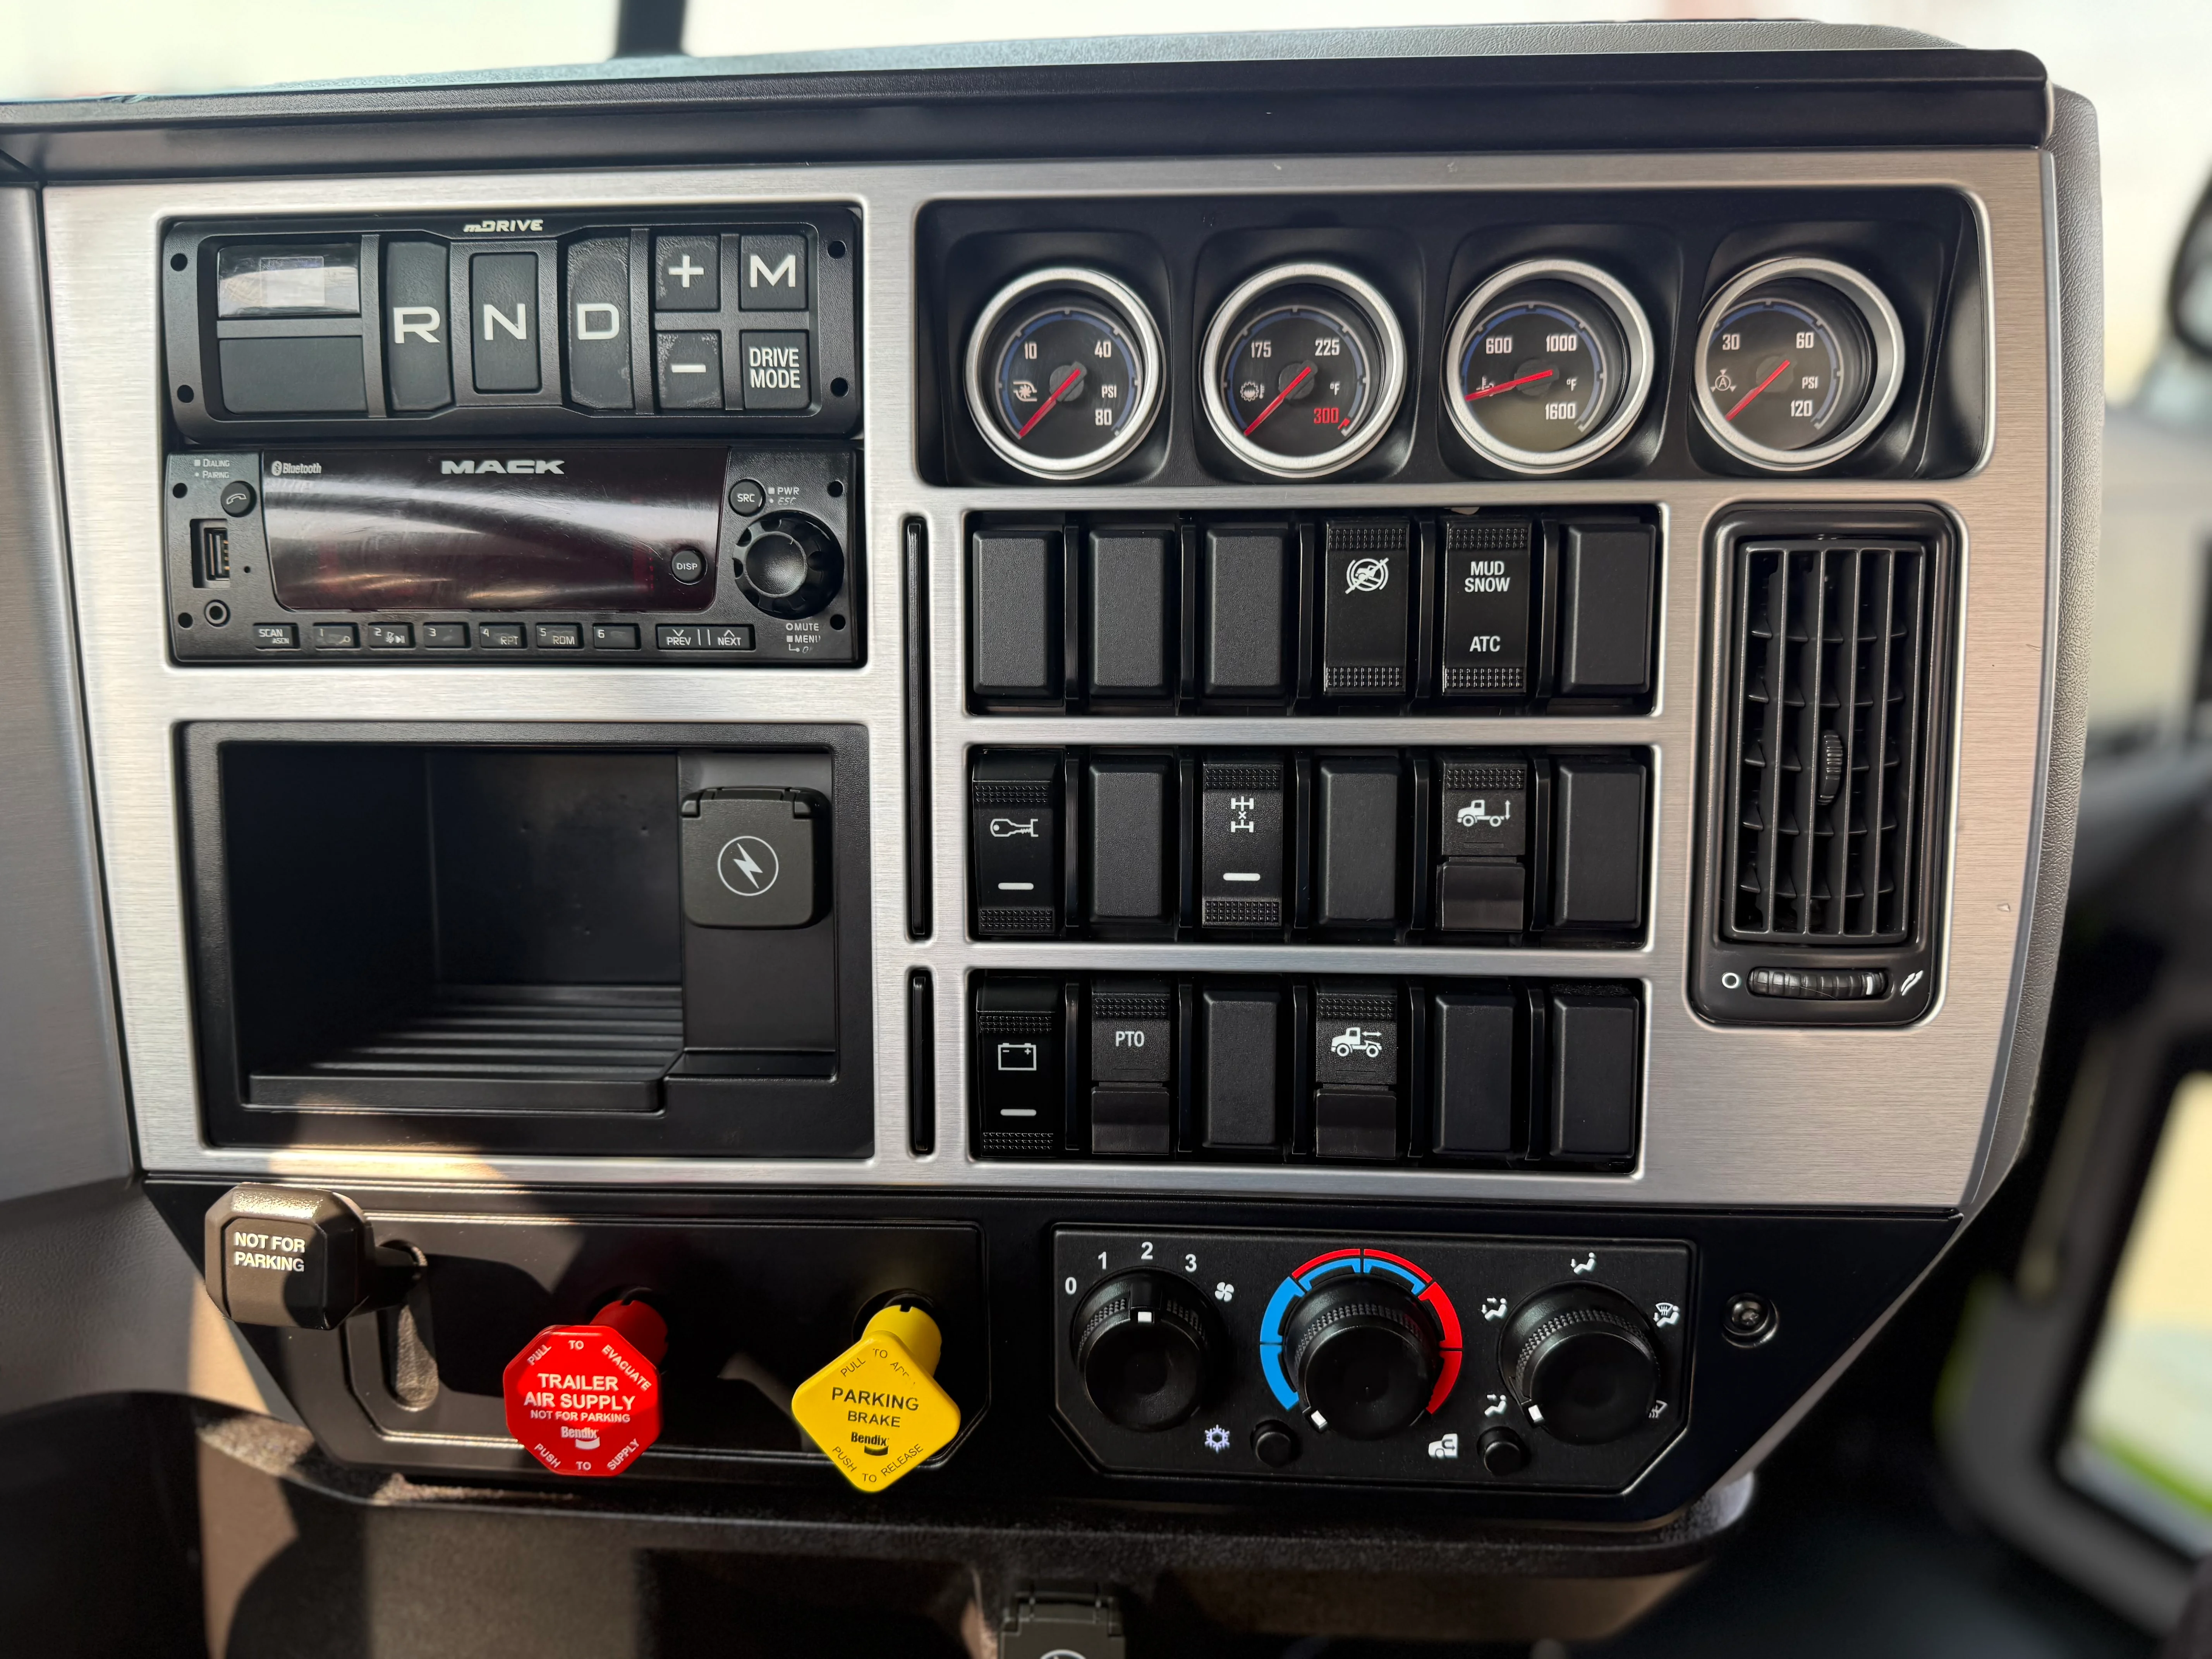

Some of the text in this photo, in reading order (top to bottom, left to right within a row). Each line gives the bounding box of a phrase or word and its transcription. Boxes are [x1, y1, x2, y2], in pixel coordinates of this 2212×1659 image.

[750, 254, 796, 288] M
[393, 306, 441, 343] R
[483, 303, 527, 340] N
[577, 303, 620, 340] D
[1251, 339, 1272, 358] 175
[1315, 337, 1340, 356] 225
[1486, 335, 1513, 354] 600
[1546, 334, 1577, 352] 1000
[1723, 333, 1741, 350] 30
[1796, 331, 1815, 349] 60
[749, 347, 799, 368] DRIVE
[1024, 342, 1037, 359] 10
[1094, 340, 1111, 358] 40
[750, 368, 801, 388] MODE
[1802, 376, 1819, 389] PSI
[1101, 384, 1117, 398] PSI
[1314, 407, 1339, 424] 300
[1545, 402, 1576, 420] 1600
[1790, 399, 1813, 417] 120
[1095, 408, 1112, 426] 80
[203, 458, 230, 467] DIALING
[282, 462, 322, 474] Bluetooth
[441, 460, 565, 474] MACK
[203, 470, 230, 479] PAIRING
[737, 493, 755, 503] SRC
[777, 486, 800, 495] PWR
[677, 562, 698, 570] DISP
[1470, 560, 1504, 576] MUD
[1464, 577, 1511, 592] SNOW
[258, 628, 283, 637] SCAN
[374, 627, 382, 636] 2
[427, 627, 436, 637] 3
[482, 628, 489, 637] 4
[539, 627, 547, 637] 5
[598, 629, 605, 639] 6
[794, 622, 819, 631] MUTE
[500, 636, 519, 645] RPT
[553, 635, 575, 645] RDM
[666, 636, 691, 646] PREV
[718, 636, 741, 646] NEXT
[795, 635, 821, 643] MENU
[1469, 635, 1501, 652] ATC
[1115, 1030, 1145, 1047] PTO
[235, 1231, 305, 1253] NOT FOR
[1141, 1241, 1153, 1261] 2
[234, 1251, 305, 1272] PARKING
[1098, 1251, 1107, 1270] 1
[1185, 1254, 1197, 1273] 3
[1065, 1276, 1077, 1295] 0
[527, 1340, 652, 1392] PULL TO EVACUATE
[840, 1357, 866, 1377] PULL
[872, 1348, 888, 1358] TO
[537, 1373, 619, 1392] TRAILER
[524, 1391, 636, 1412] AIR SUPPLY
[831, 1386, 919, 1411] PARKING
[530, 1409, 631, 1424] NOT FOR PARKING
[847, 1410, 901, 1428] BRAKE
[560, 1426, 599, 1439] Bendix
[851, 1431, 888, 1447] Bendix
[534, 1438, 640, 1471] PUSH TO SUPPLY
[832, 1443, 924, 1483] PUSH TO RELEASE
